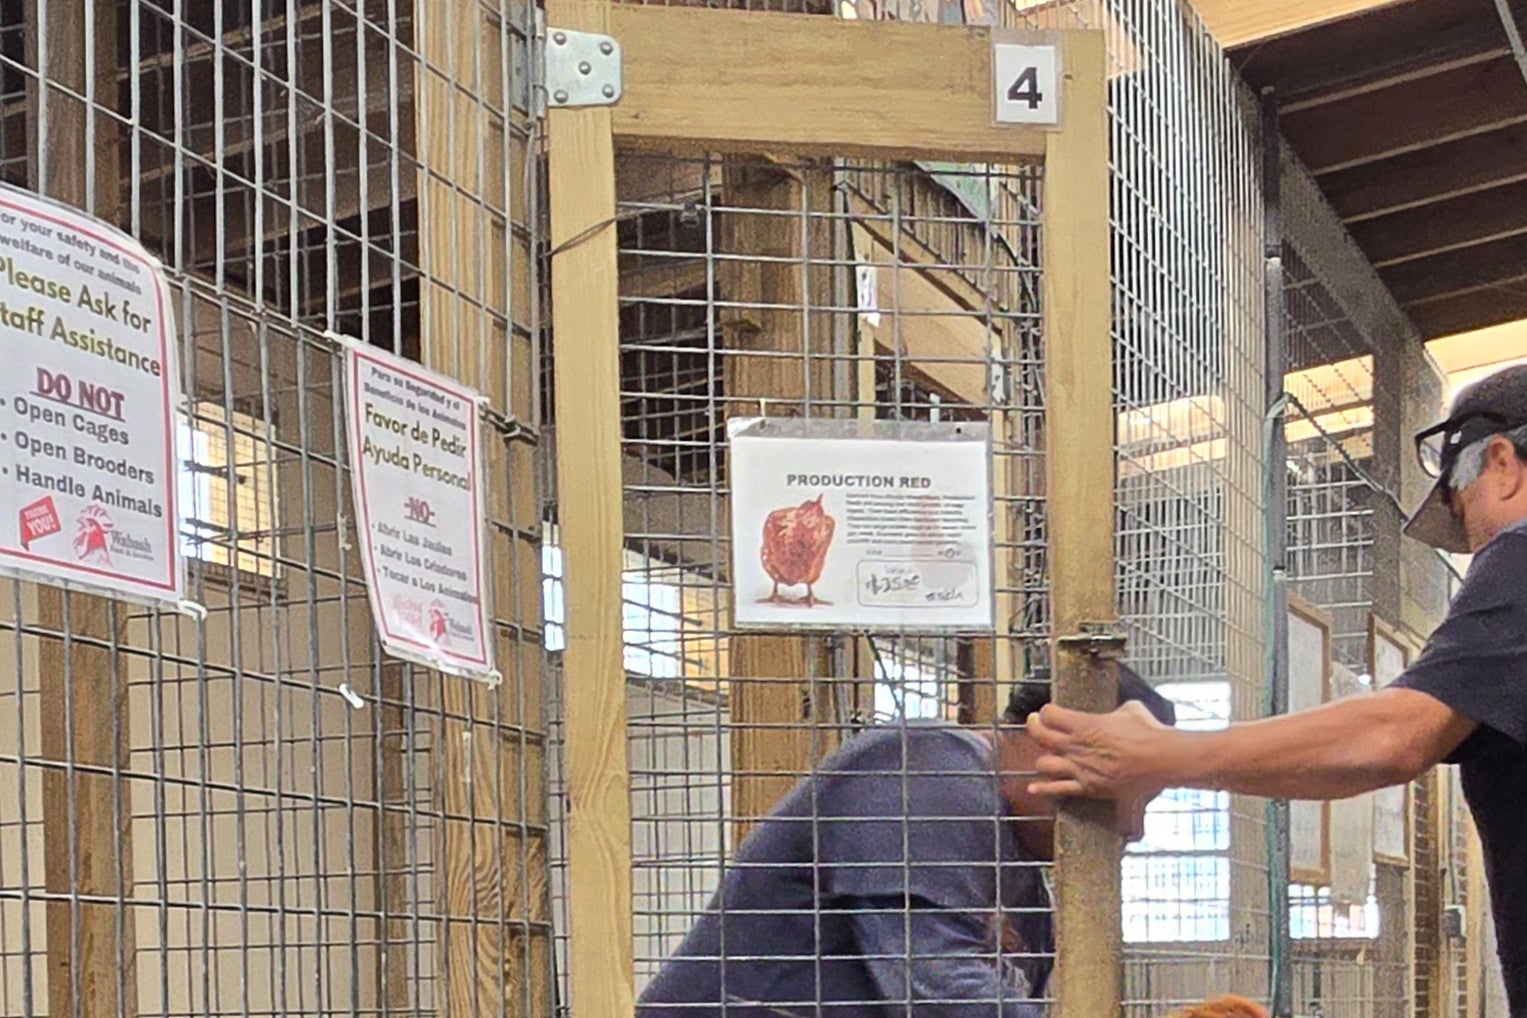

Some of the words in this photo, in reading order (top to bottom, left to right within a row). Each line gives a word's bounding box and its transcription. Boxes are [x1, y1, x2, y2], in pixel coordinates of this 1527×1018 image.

[1007, 67, 1043, 109] 4
[0, 212, 16, 225] or
[20, 218, 52, 237] your
[56, 230, 96, 257] safety
[57, 253, 71, 267] of
[74, 261, 95, 276] our
[97, 269, 142, 296] animals
[77, 283, 118, 322] Ask
[122, 300, 151, 333] for
[0, 301, 45, 336] taff
[50, 315, 161, 377] Assistance
[36, 366, 72, 401] DO
[78, 379, 126, 418] NOT
[14, 396, 67, 428] Open
[72, 413, 129, 445] Cages
[364, 402, 409, 437] Favor
[410, 420, 429, 445] de
[432, 427, 468, 459] Pedir
[14, 430, 67, 461] Open
[73, 446, 155, 485] Brooders
[362, 434, 410, 470] Ayuda
[412, 451, 472, 493] Personal
[785, 474, 896, 489] PRODUCTION
[899, 475, 932, 489] RED
[15, 463, 86, 498] Handle
[91, 484, 163, 519] Animals
[26, 513, 58, 537] YOU!
